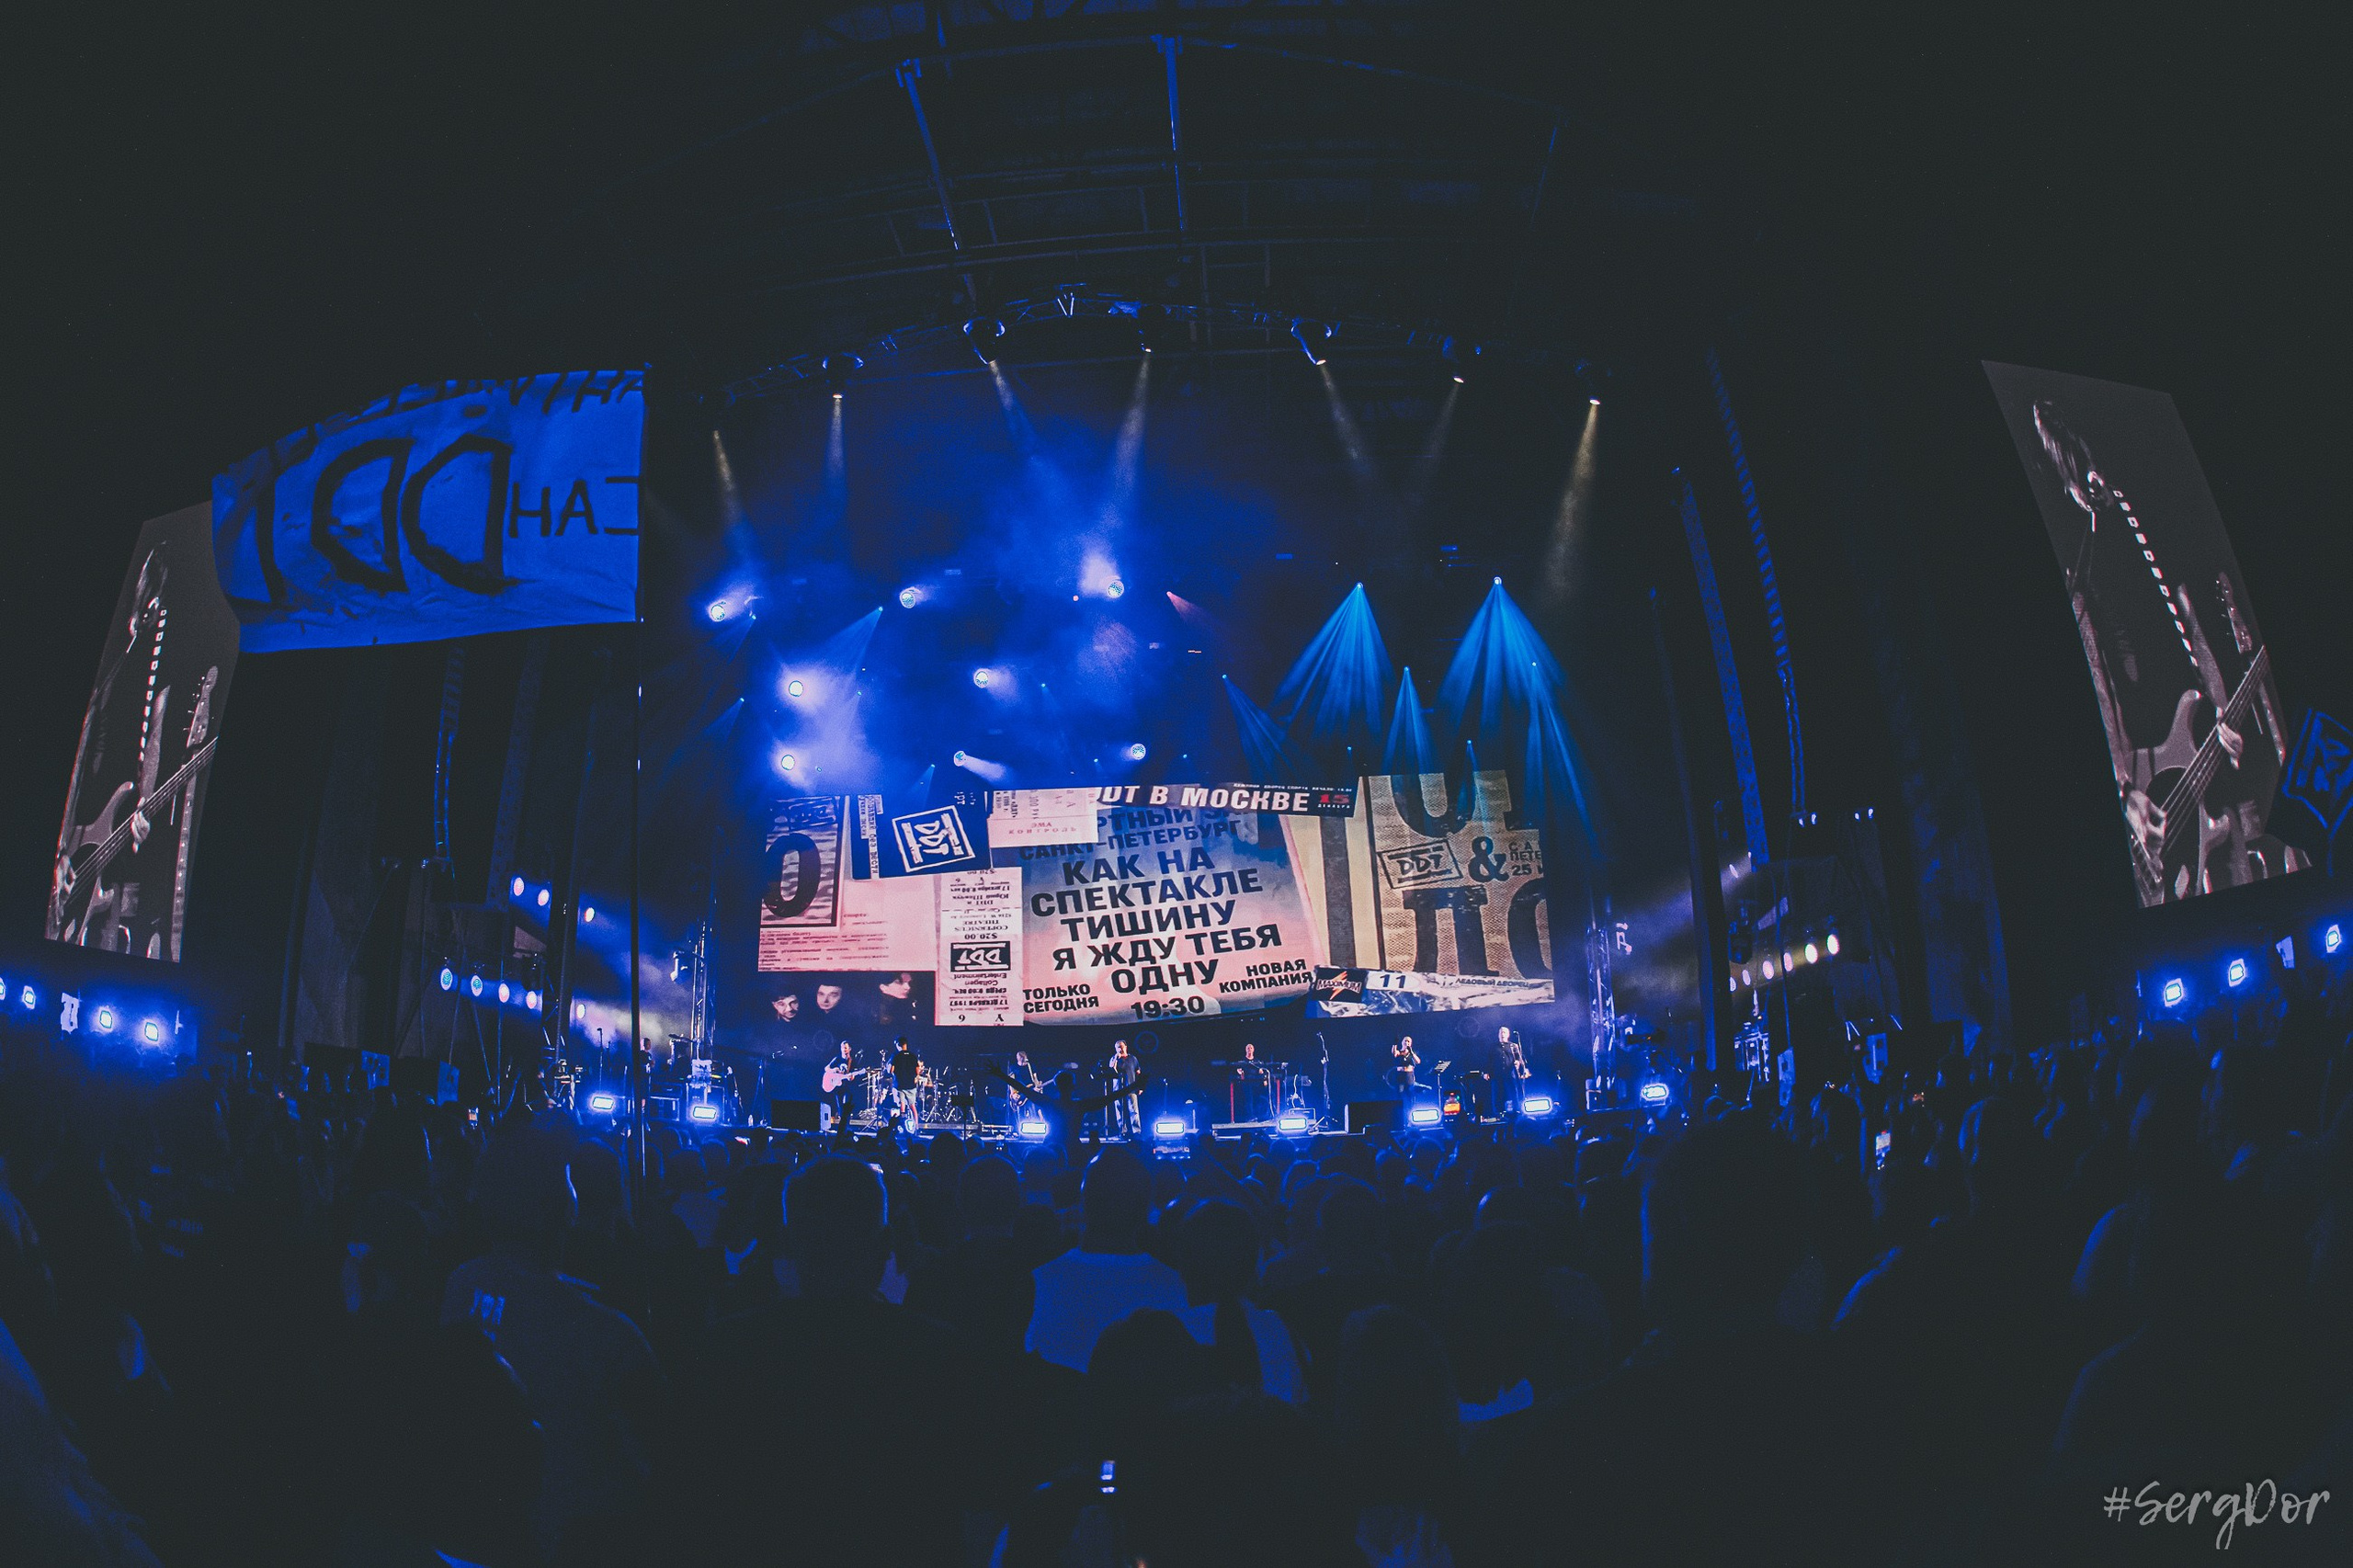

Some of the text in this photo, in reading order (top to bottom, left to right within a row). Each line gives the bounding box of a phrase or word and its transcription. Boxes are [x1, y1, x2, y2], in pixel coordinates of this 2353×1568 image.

[1150, 786, 1168, 804] В
[1181, 788, 1310, 812] МОСКВЕ
[1319, 793, 1350, 804] 15
[1063, 846, 1215, 886] КАК НА
[1031, 869, 1263, 916] СПЕКТАКЛЕ
[1061, 899, 1236, 942] ТИШИНУ
[1052, 923, 1282, 971] Я ЖДУ ТЕБЯ
[1110, 959, 1219, 995] ОДНУ
[1246, 959, 1307, 977] НОВАЯ
[1022, 983, 1091, 1000] ТОЛЬКО
[1219, 971, 1313, 994] КОМПАНИЯ
[1317, 978, 1361, 994] MAXIMUM
[1379, 973, 1407, 989] 11
[1455, 977, 1495, 987] ЛЕДОВЫЙ
[1023, 995, 1099, 1014] СЕГОДНЯ
[1131, 995, 1205, 1019] 19:30
[958, 1014, 966, 1023] 6
